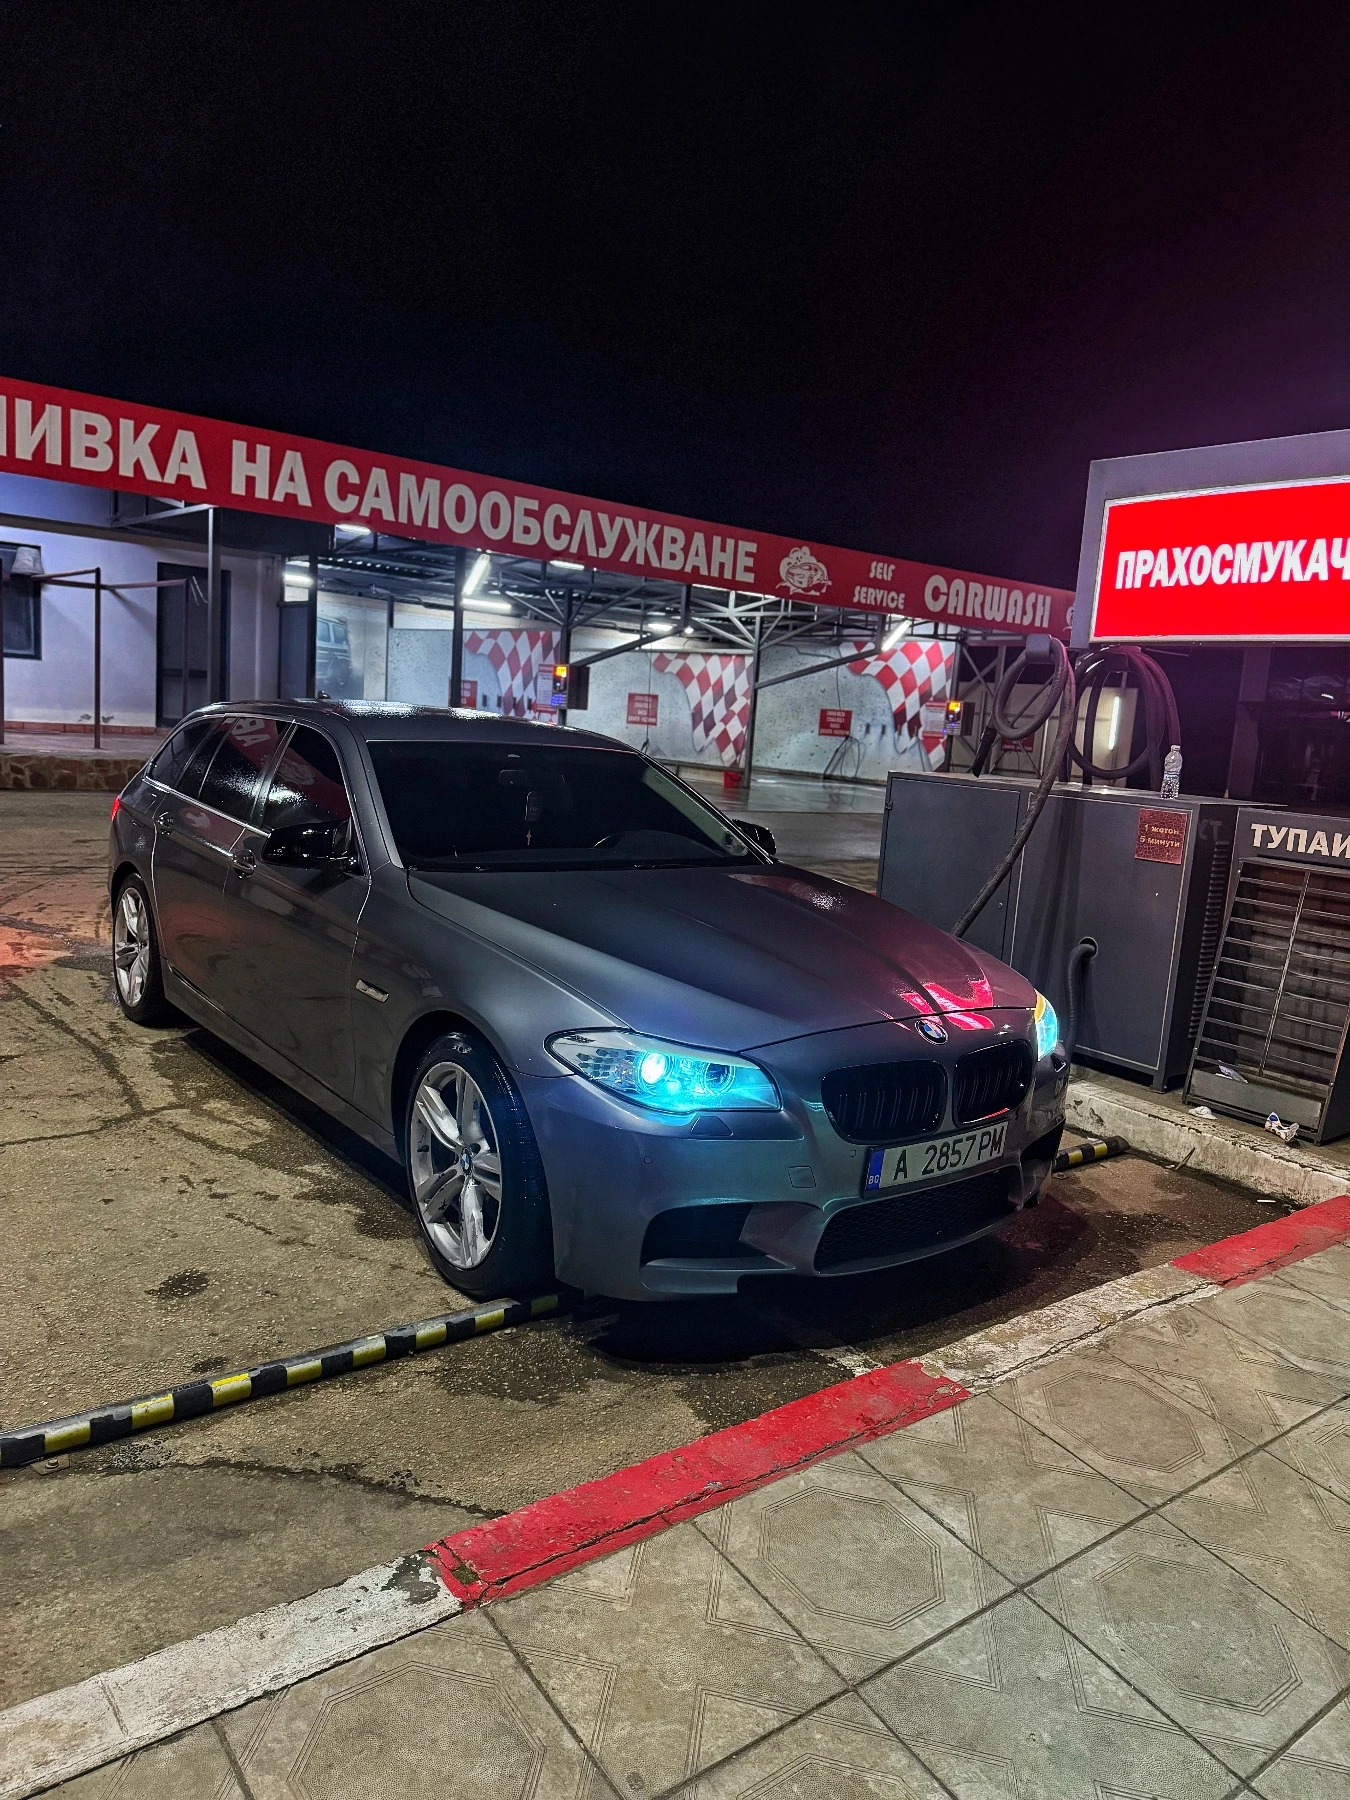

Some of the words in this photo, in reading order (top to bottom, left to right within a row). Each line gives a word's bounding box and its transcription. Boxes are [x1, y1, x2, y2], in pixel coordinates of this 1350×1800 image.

[0, 394, 207, 489] ИВКА
[231, 439, 312, 507] НА
[324, 459, 757, 582] САМООБСЛУЖВАНЕ
[869, 561, 896, 582] SELF
[1115, 538, 1350, 589] ПРАХОСМУКАЧ
[853, 585, 905, 610] SERVICE
[924, 574, 1051, 628] CARWASH
[1139, 835, 1146, 843] 5
[1147, 837, 1180, 848] минути
[893, 1149, 908, 1181] A
[868, 1174, 880, 1185] BG
